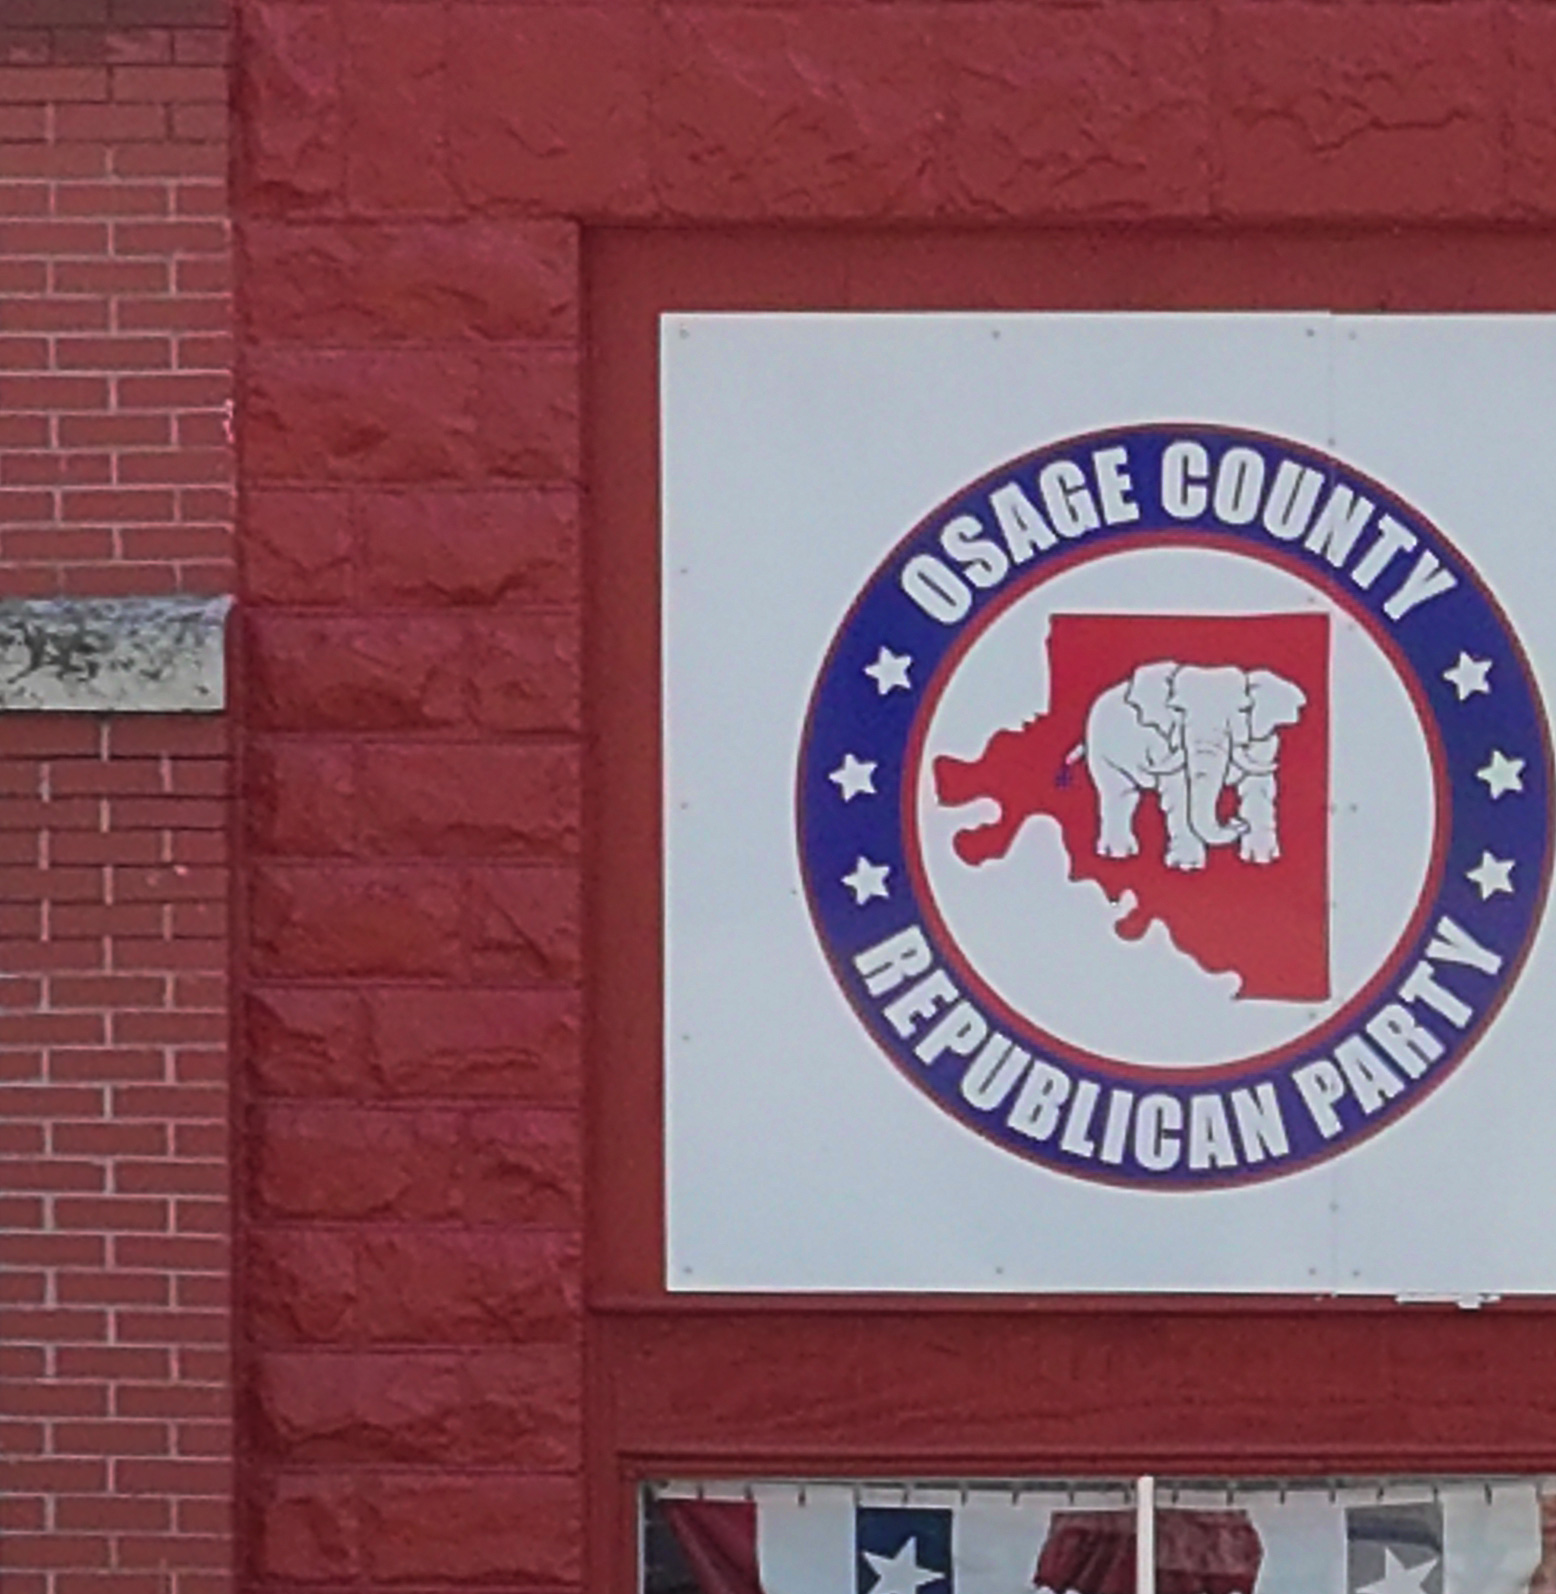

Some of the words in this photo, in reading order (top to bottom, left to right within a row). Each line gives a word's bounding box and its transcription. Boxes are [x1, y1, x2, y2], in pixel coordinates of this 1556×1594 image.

[901, 447, 1140, 625] OSAGE
[1161, 440, 1457, 622] COUNTY
[853, 924, 1291, 1171] REPUBLICAN
[1292, 915, 1504, 1137] PARTY
